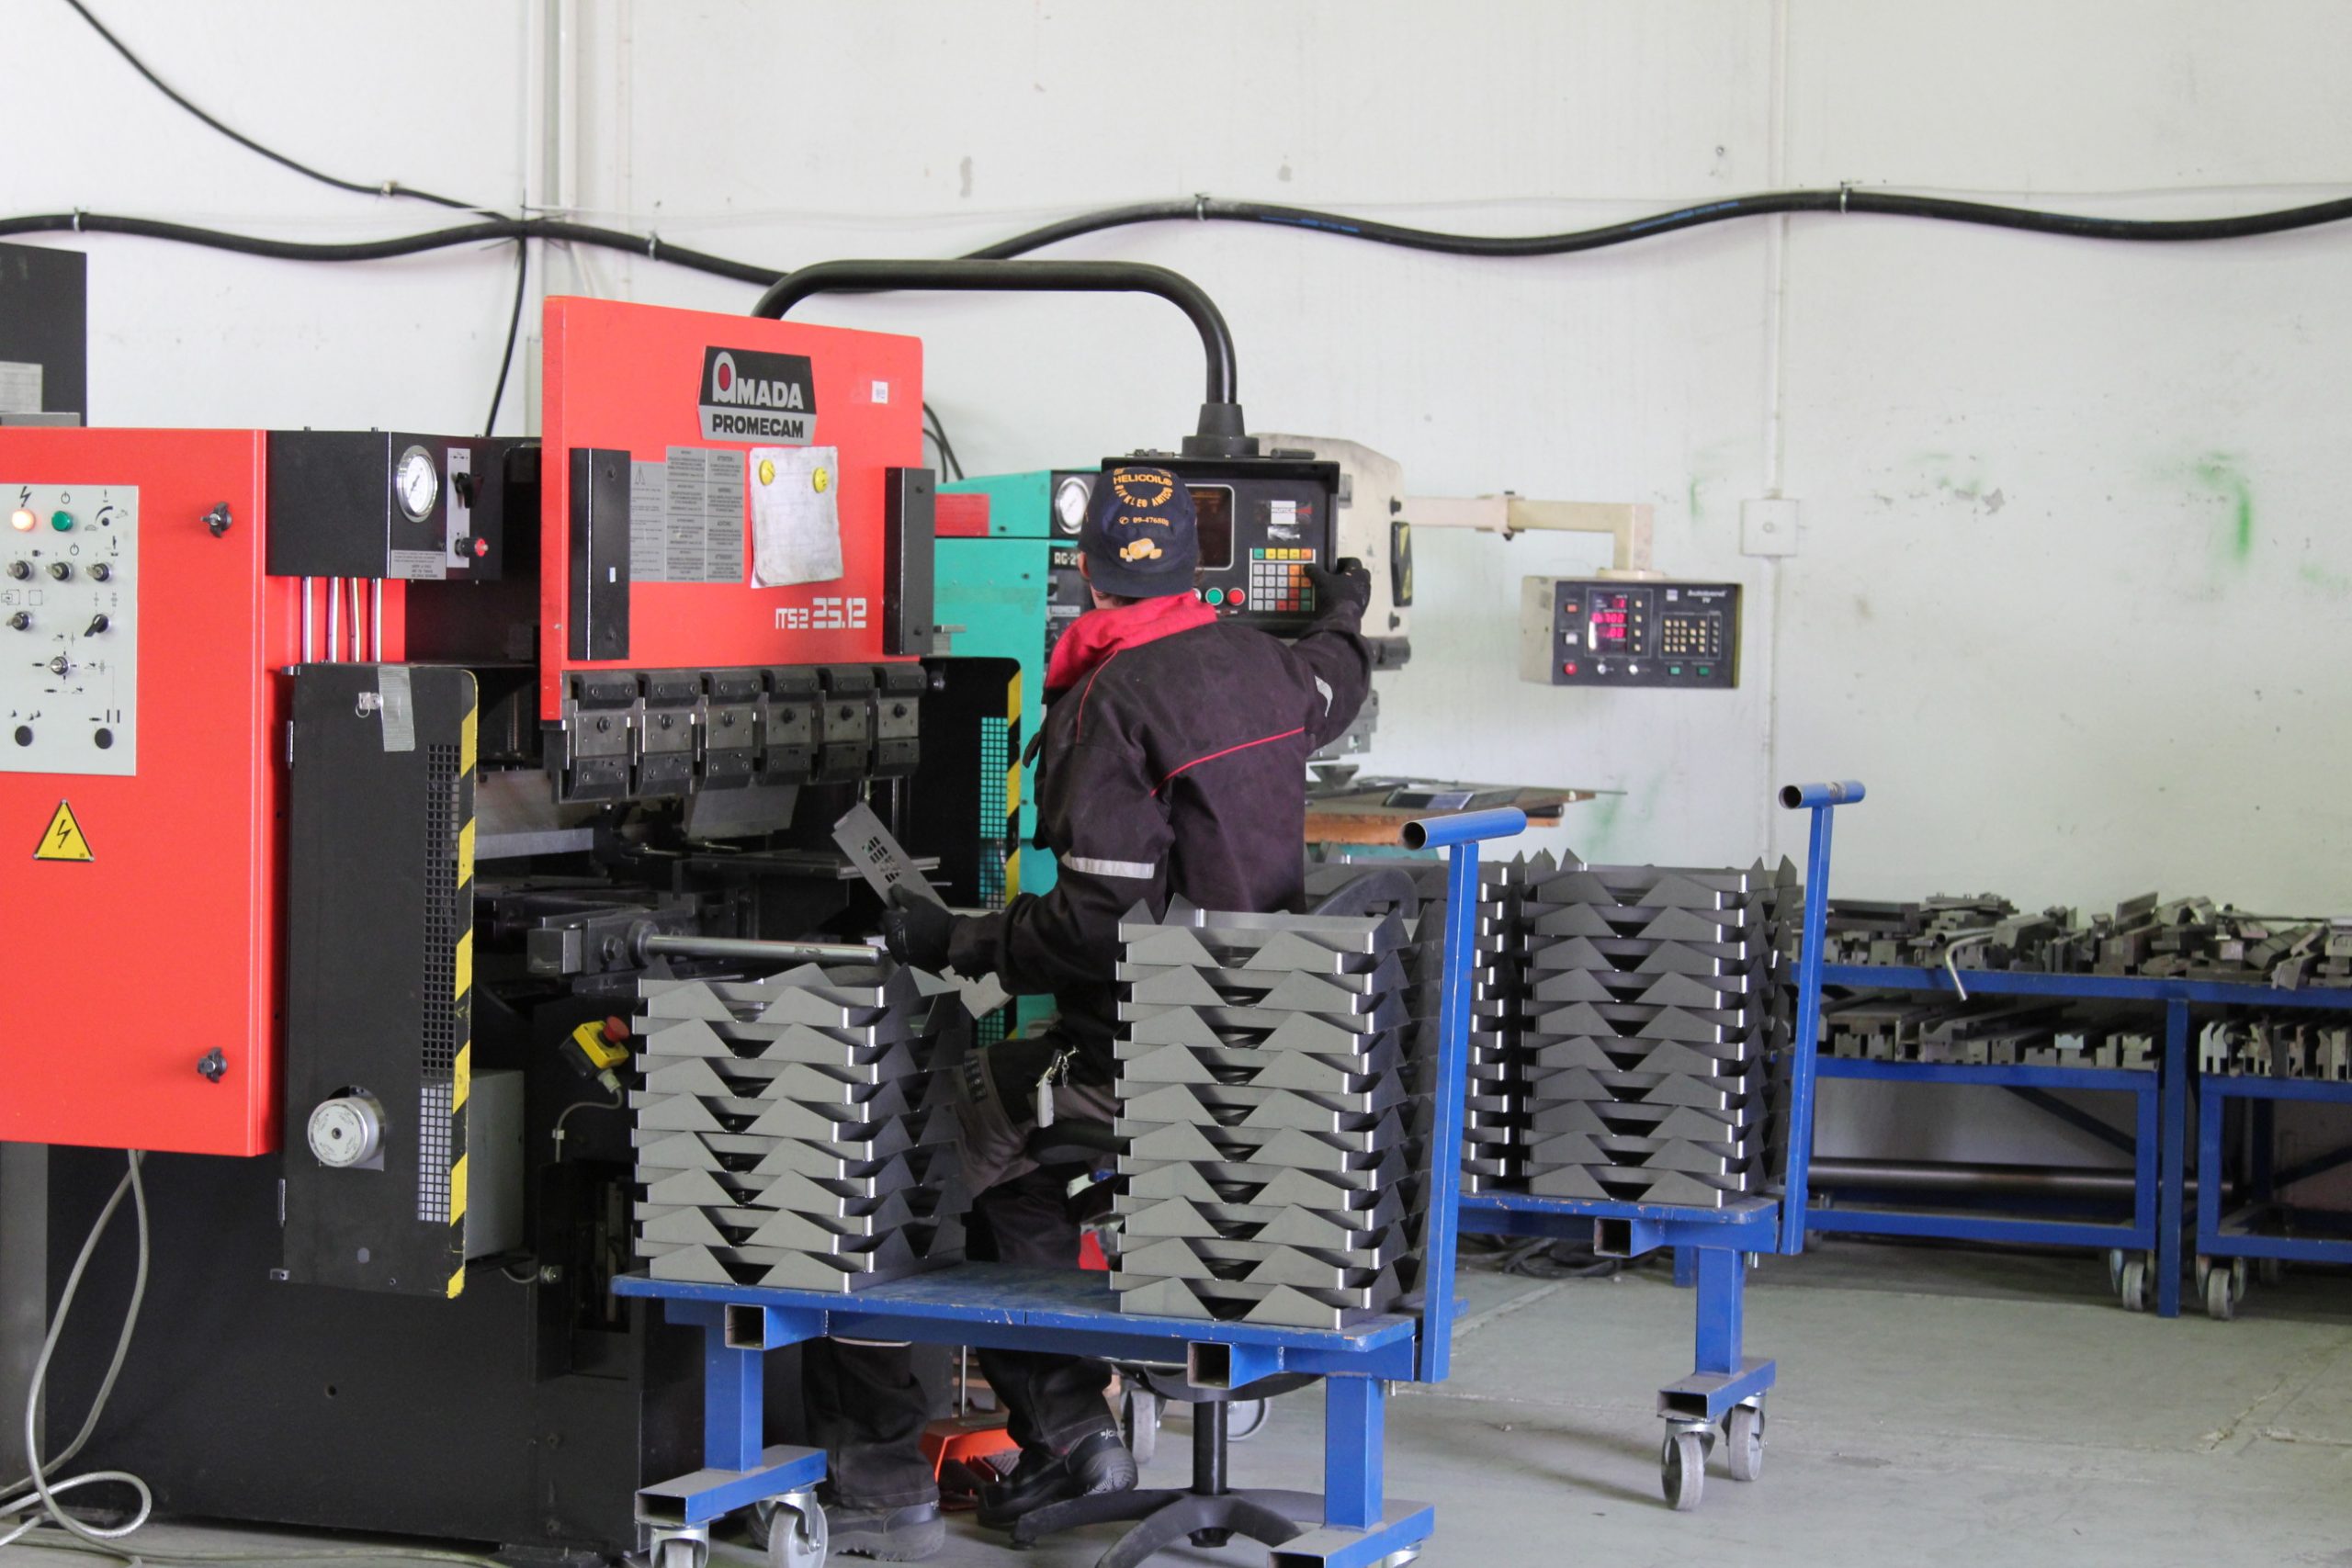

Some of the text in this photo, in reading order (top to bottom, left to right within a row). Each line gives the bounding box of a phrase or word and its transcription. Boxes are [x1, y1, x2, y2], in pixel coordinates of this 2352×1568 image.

[712, 351, 804, 410] AMADA
[712, 413, 804, 438] PROMECAM
[812, 597, 867, 629] 25.12
